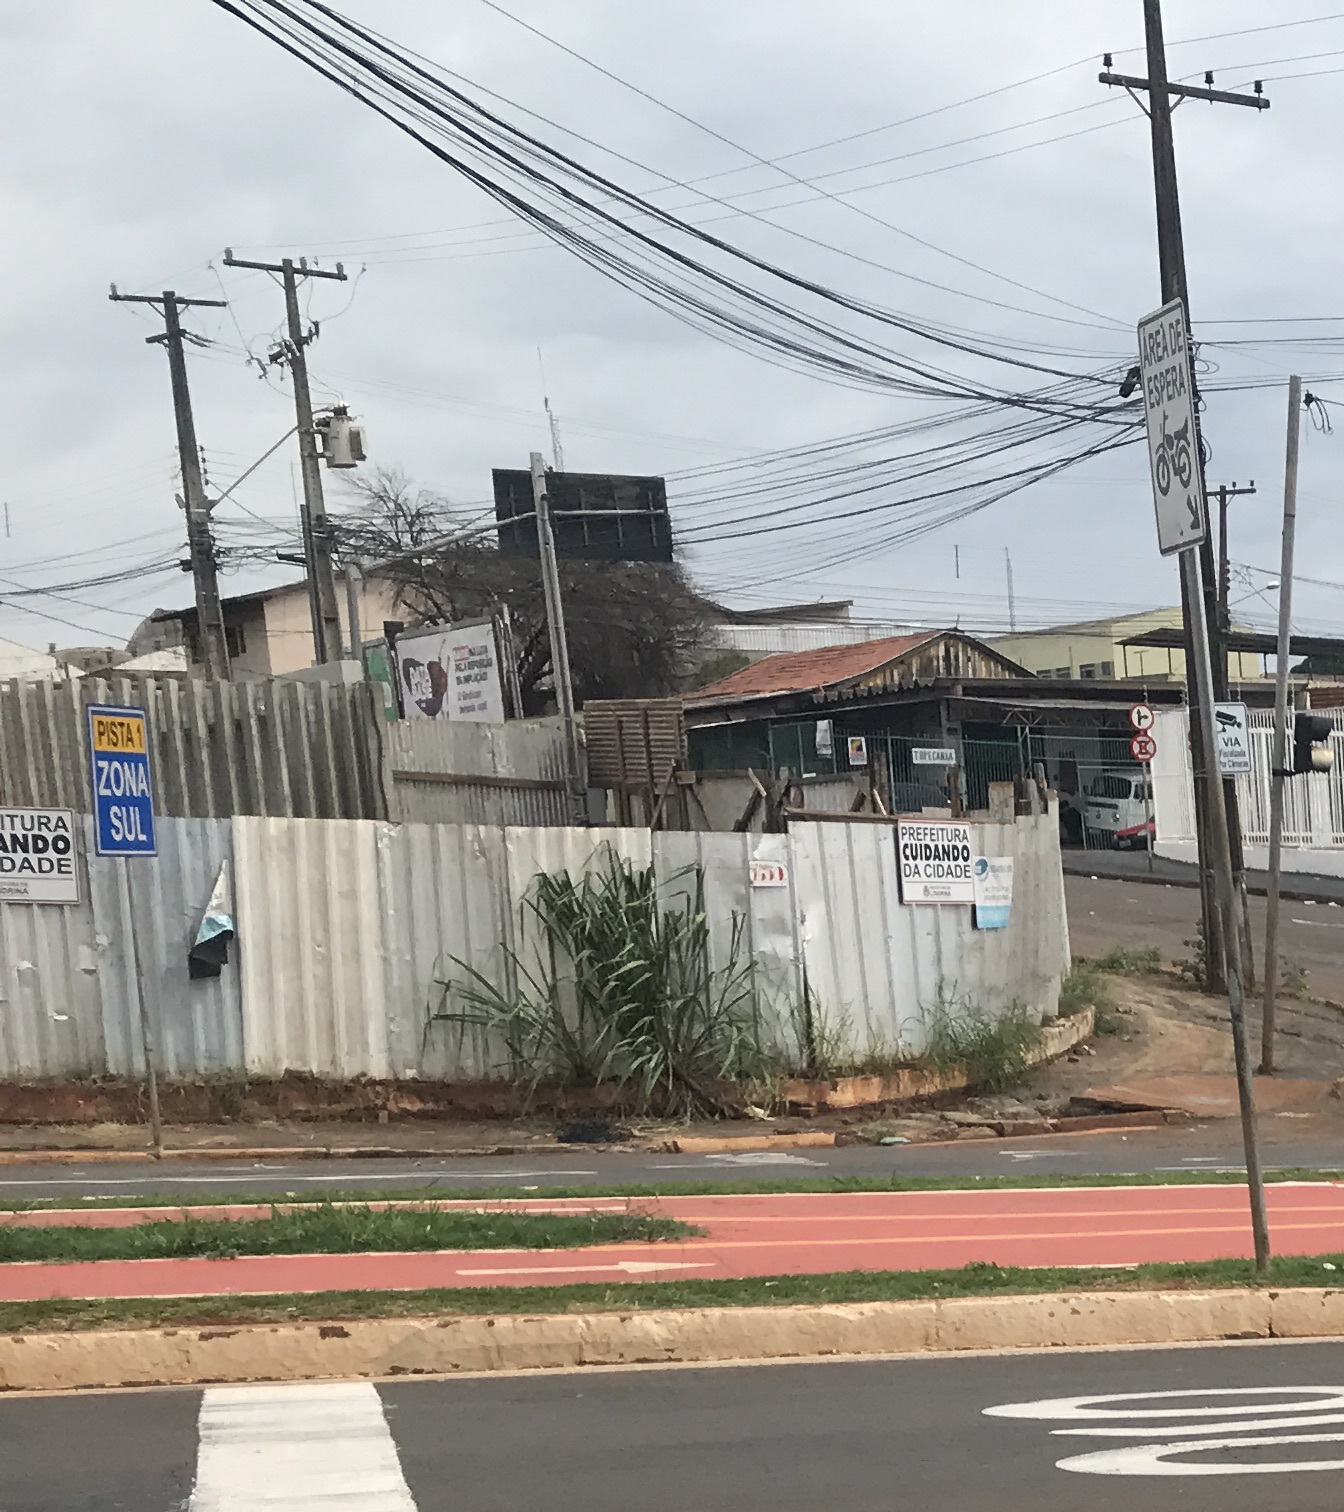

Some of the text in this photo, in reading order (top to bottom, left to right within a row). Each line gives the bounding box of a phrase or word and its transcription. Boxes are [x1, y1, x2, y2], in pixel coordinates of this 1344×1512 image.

[1169, 318, 1183, 356] DE
[1147, 363, 1187, 410] ESPERA
[97, 720, 144, 748] PISTA 1
[1222, 736, 1241, 747] VIA
[98, 760, 150, 798] ZONA
[110, 805, 147, 842] SUL
[901, 827, 969, 843] PREFEITURA
[903, 844, 970, 862] CUIDANDO
[904, 864, 972, 879] DA CIDADE
